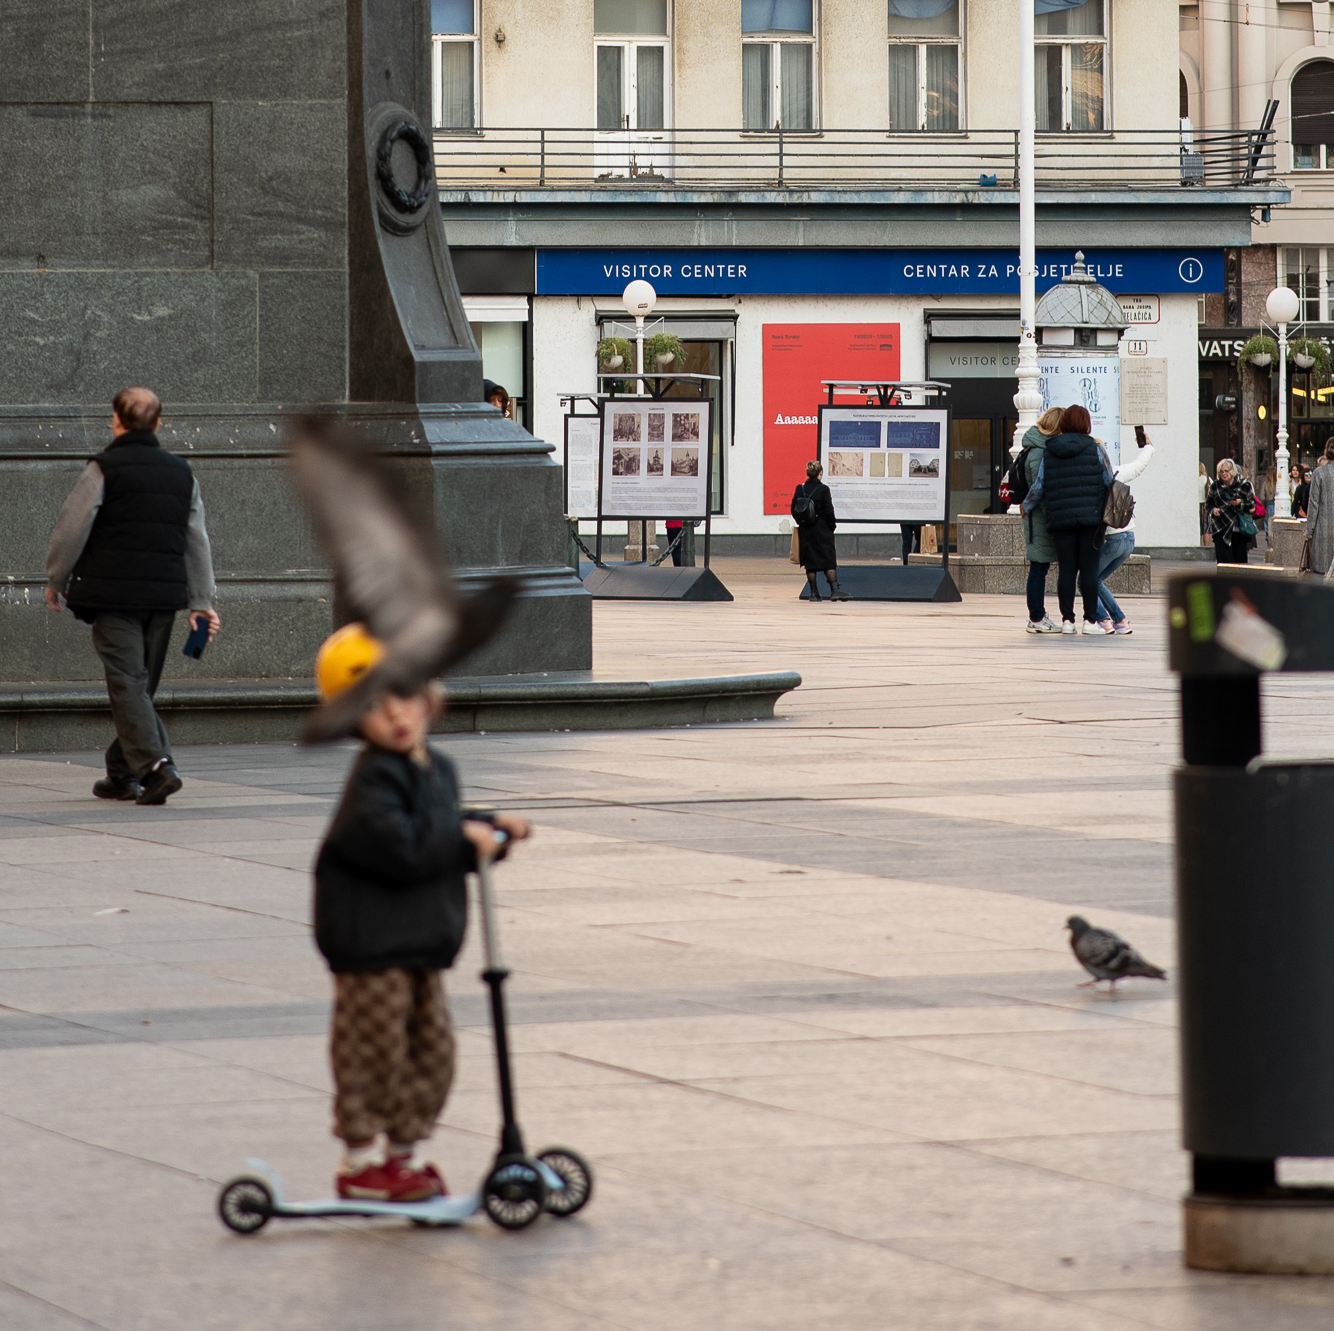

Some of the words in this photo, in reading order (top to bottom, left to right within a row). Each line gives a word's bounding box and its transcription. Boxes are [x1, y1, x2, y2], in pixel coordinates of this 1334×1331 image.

[603, 264, 673, 278] VISITOR
[681, 264, 747, 278] CENTER
[904, 265, 969, 278] CENTAR
[978, 265, 998, 277] ZA
[1007, 264, 1123, 277] PSJETIELJE
[1134, 342, 1142, 350] 11
[950, 357, 996, 365] VISITOR
